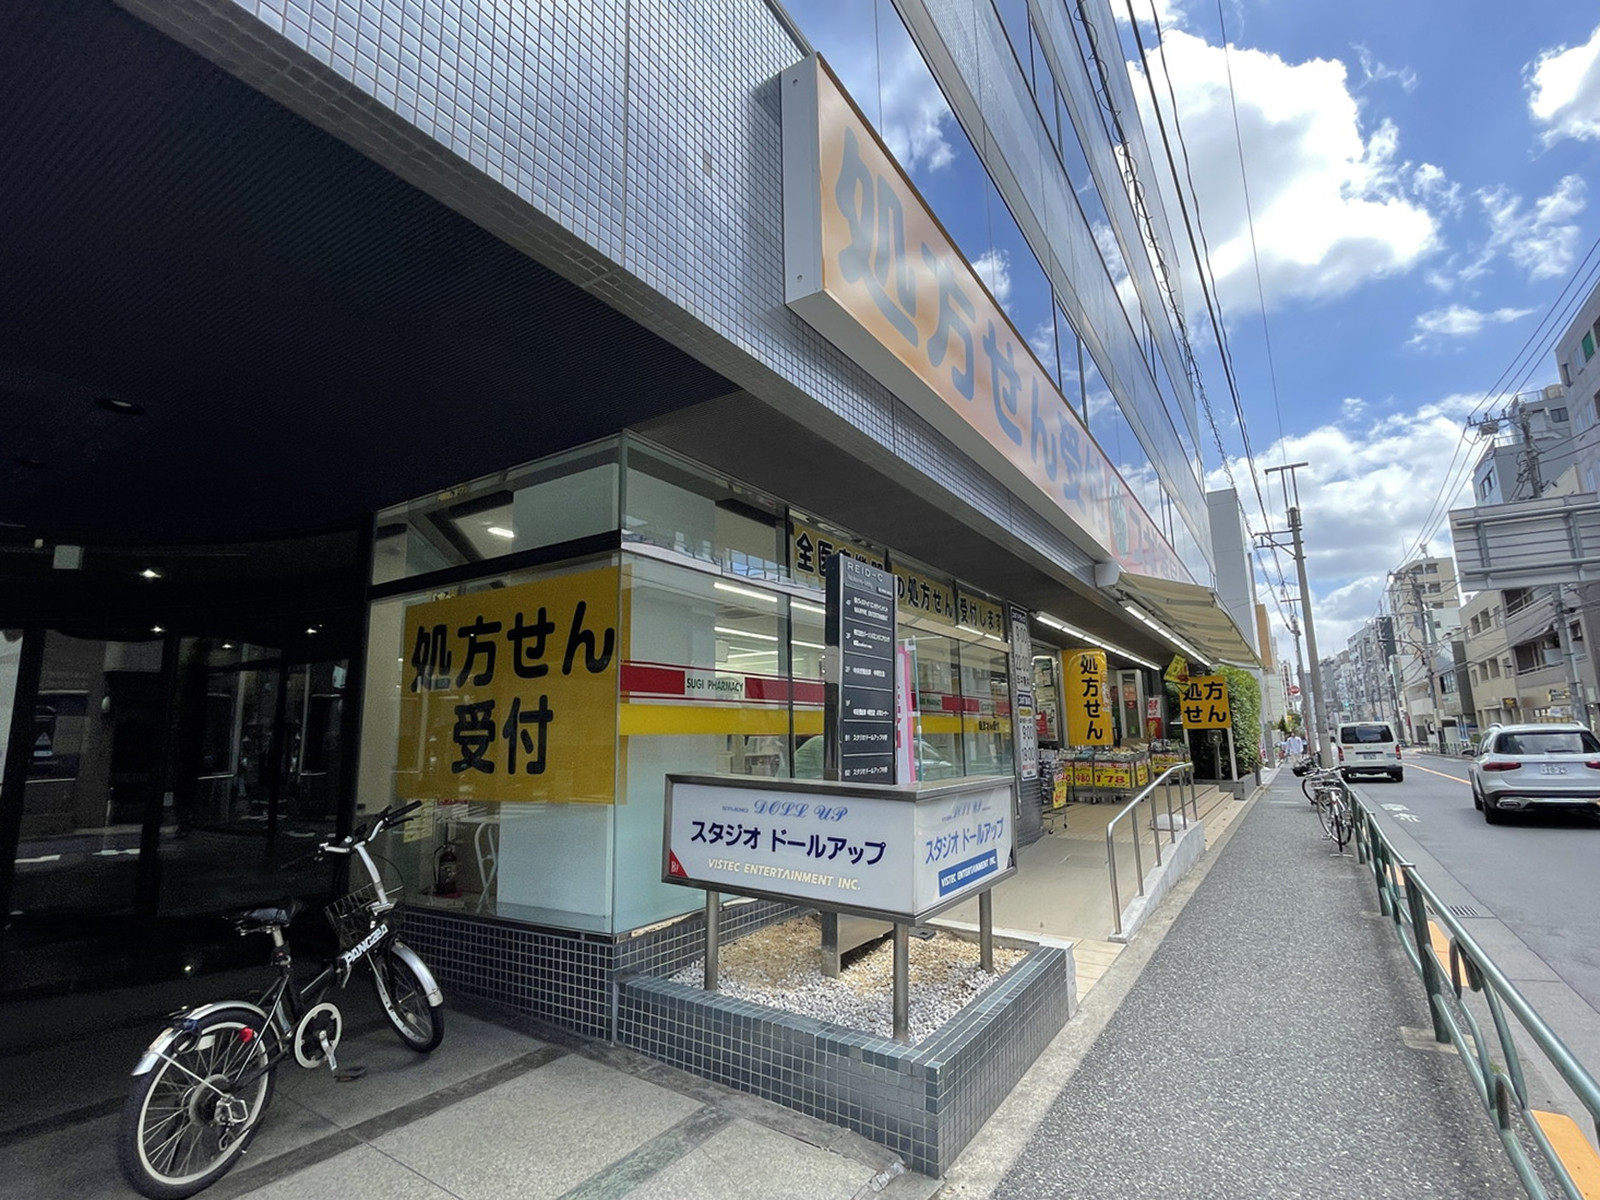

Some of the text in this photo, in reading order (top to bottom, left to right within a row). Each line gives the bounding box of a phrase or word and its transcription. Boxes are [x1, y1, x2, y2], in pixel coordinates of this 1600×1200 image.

[848, 562, 883, 582] REID-C
[411, 601, 615, 692] 処方せん
[686, 678, 743, 692] SUGI PHARMACY
[1080, 655, 1103, 740] 処方せん
[1183, 682, 1224, 701] 処方
[1183, 705, 1227, 723] せん
[451, 695, 554, 775] 受付
[691, 820, 887, 866] スタジオ ドールアップ
[925, 817, 1004, 864] スタジオ ドールアップ
[708, 858, 861, 891] VISTEC ENTERTAINMENT INC.
